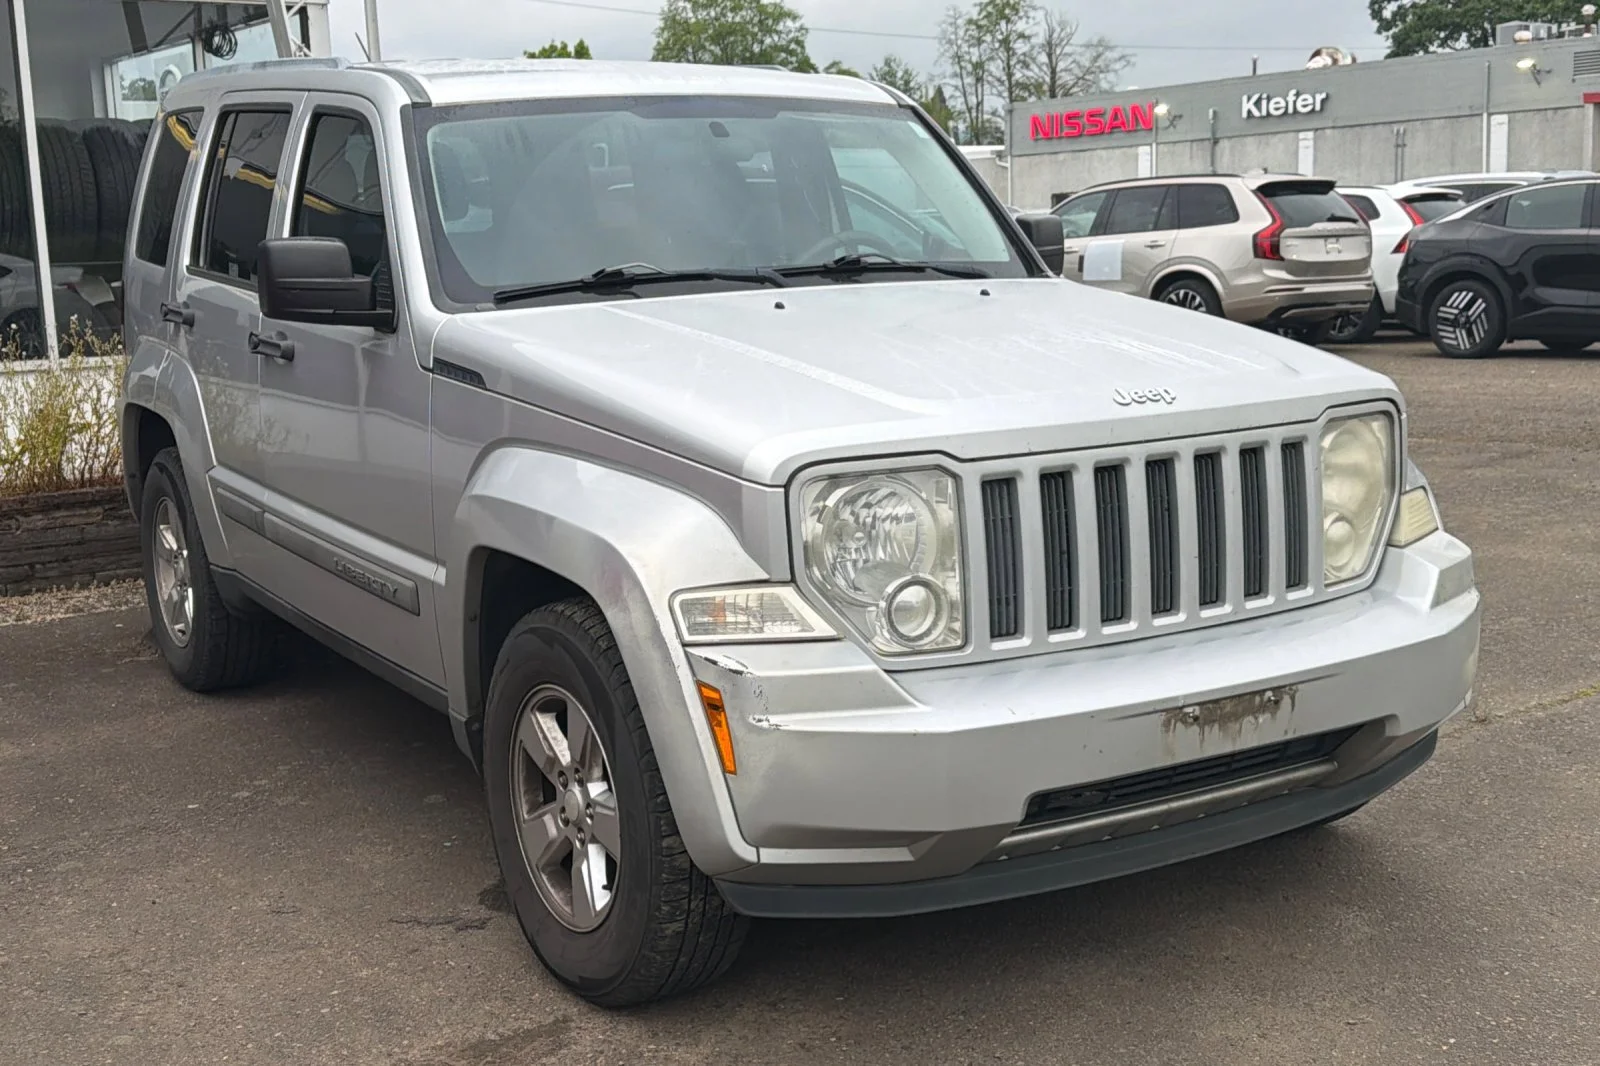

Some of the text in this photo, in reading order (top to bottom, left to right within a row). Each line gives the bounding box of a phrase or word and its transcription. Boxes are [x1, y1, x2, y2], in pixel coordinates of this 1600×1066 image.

[1241, 88, 1327, 119] Kiefer
[1029, 102, 1154, 140] NISSAN
[1112, 386, 1177, 407] Jeep
[333, 556, 399, 600] LIBERTY
